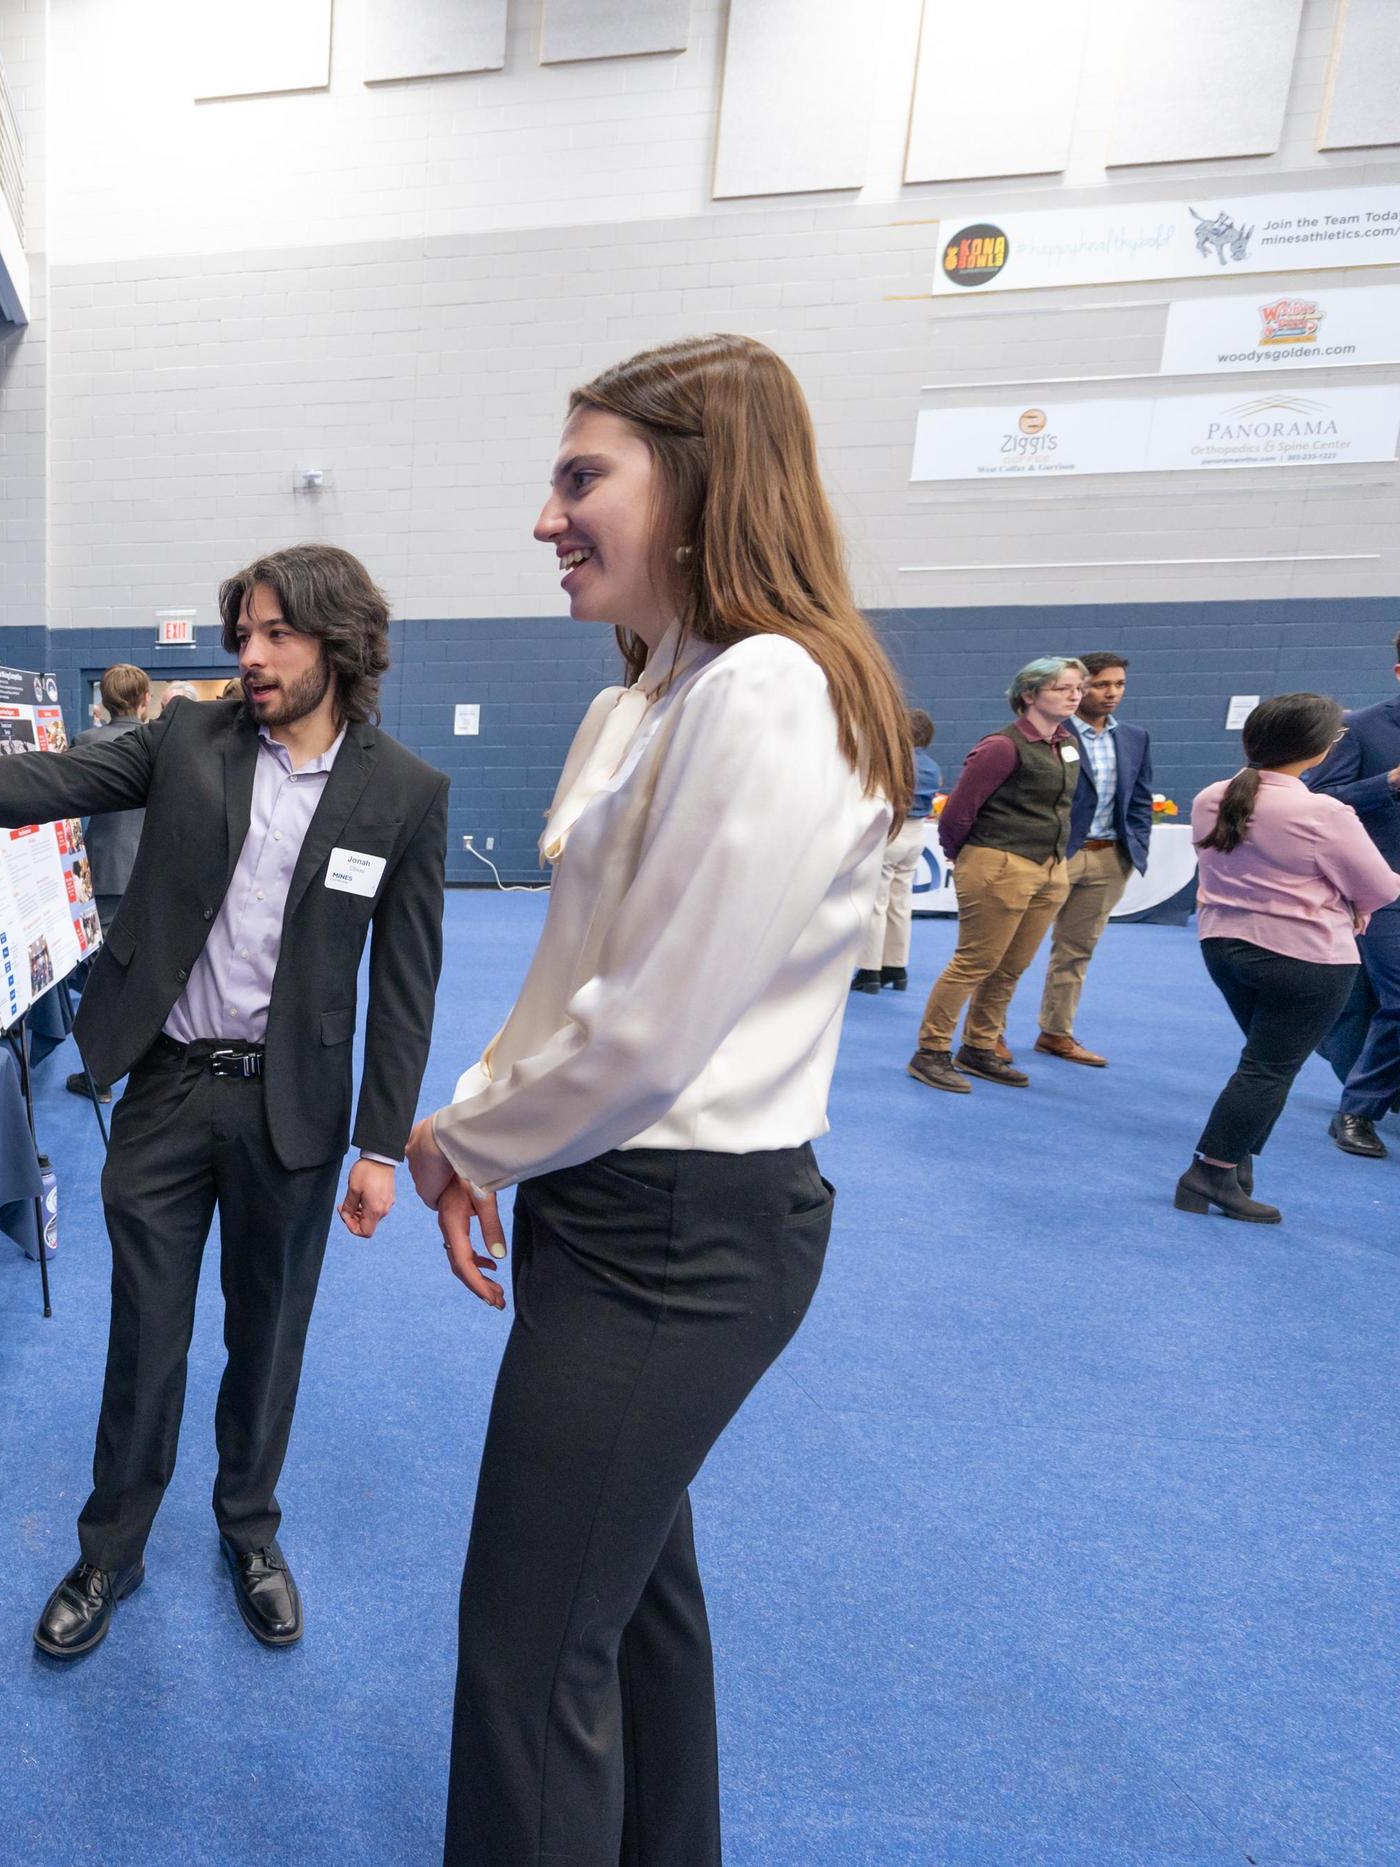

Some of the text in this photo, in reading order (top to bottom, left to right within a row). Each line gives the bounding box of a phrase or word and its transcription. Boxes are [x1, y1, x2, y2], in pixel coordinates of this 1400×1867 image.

[1263, 211, 1400, 231] Join the Team Toda
[959, 236, 1005, 256] KONA
[957, 253, 1004, 269] BOWLS
[1217, 344, 1356, 363] woodysgolden.com
[1207, 420, 1338, 440] PANORAMA
[1000, 434, 1058, 455] Ziggi's
[1190, 439, 1352, 456] Orthopedics & Spine Center
[165, 622, 187, 640] EXIT
[347, 856, 371, 867] Jonah
[332, 872, 353, 882] MINES
